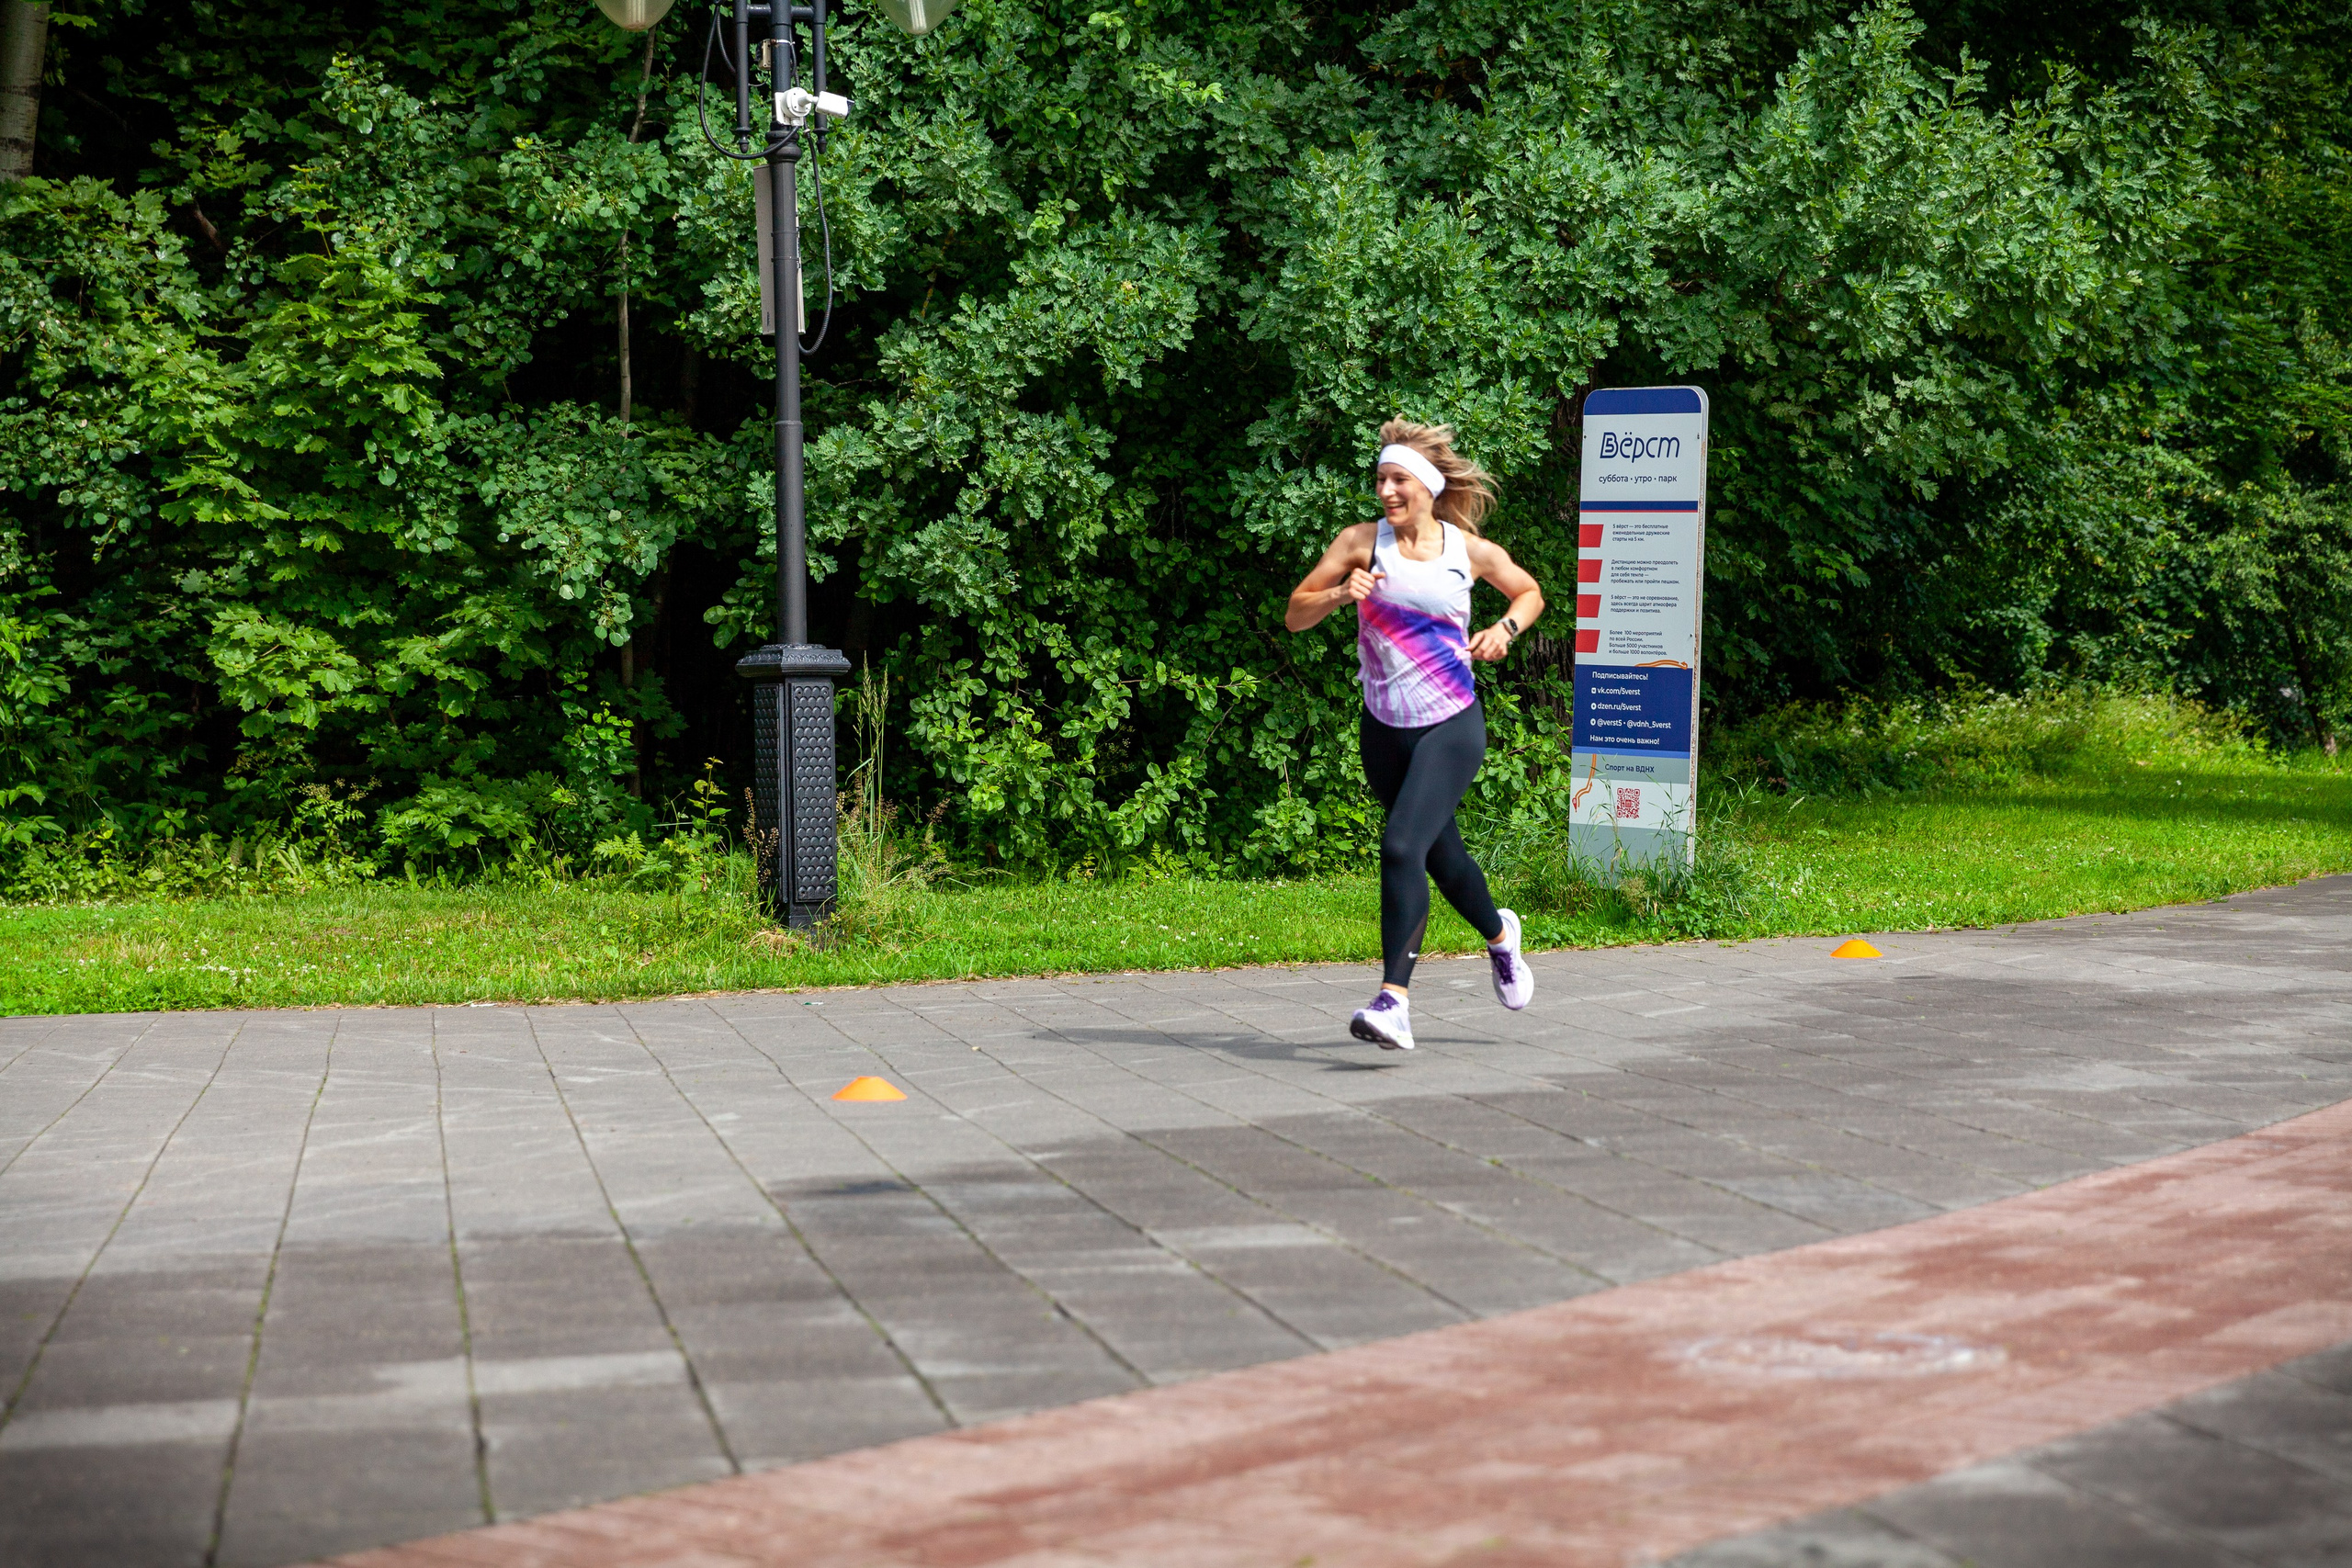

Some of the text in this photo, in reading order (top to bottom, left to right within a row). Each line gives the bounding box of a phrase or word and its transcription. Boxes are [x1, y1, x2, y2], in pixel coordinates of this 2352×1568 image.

[1599, 474, 1628, 484] суббота
[1592, 671, 1648, 680] Подписывайтесь!
[1598, 703, 1641, 711] dzen.ru/5verst
[1597, 719, 1671, 729] @verst5 @vdnh_5verst
